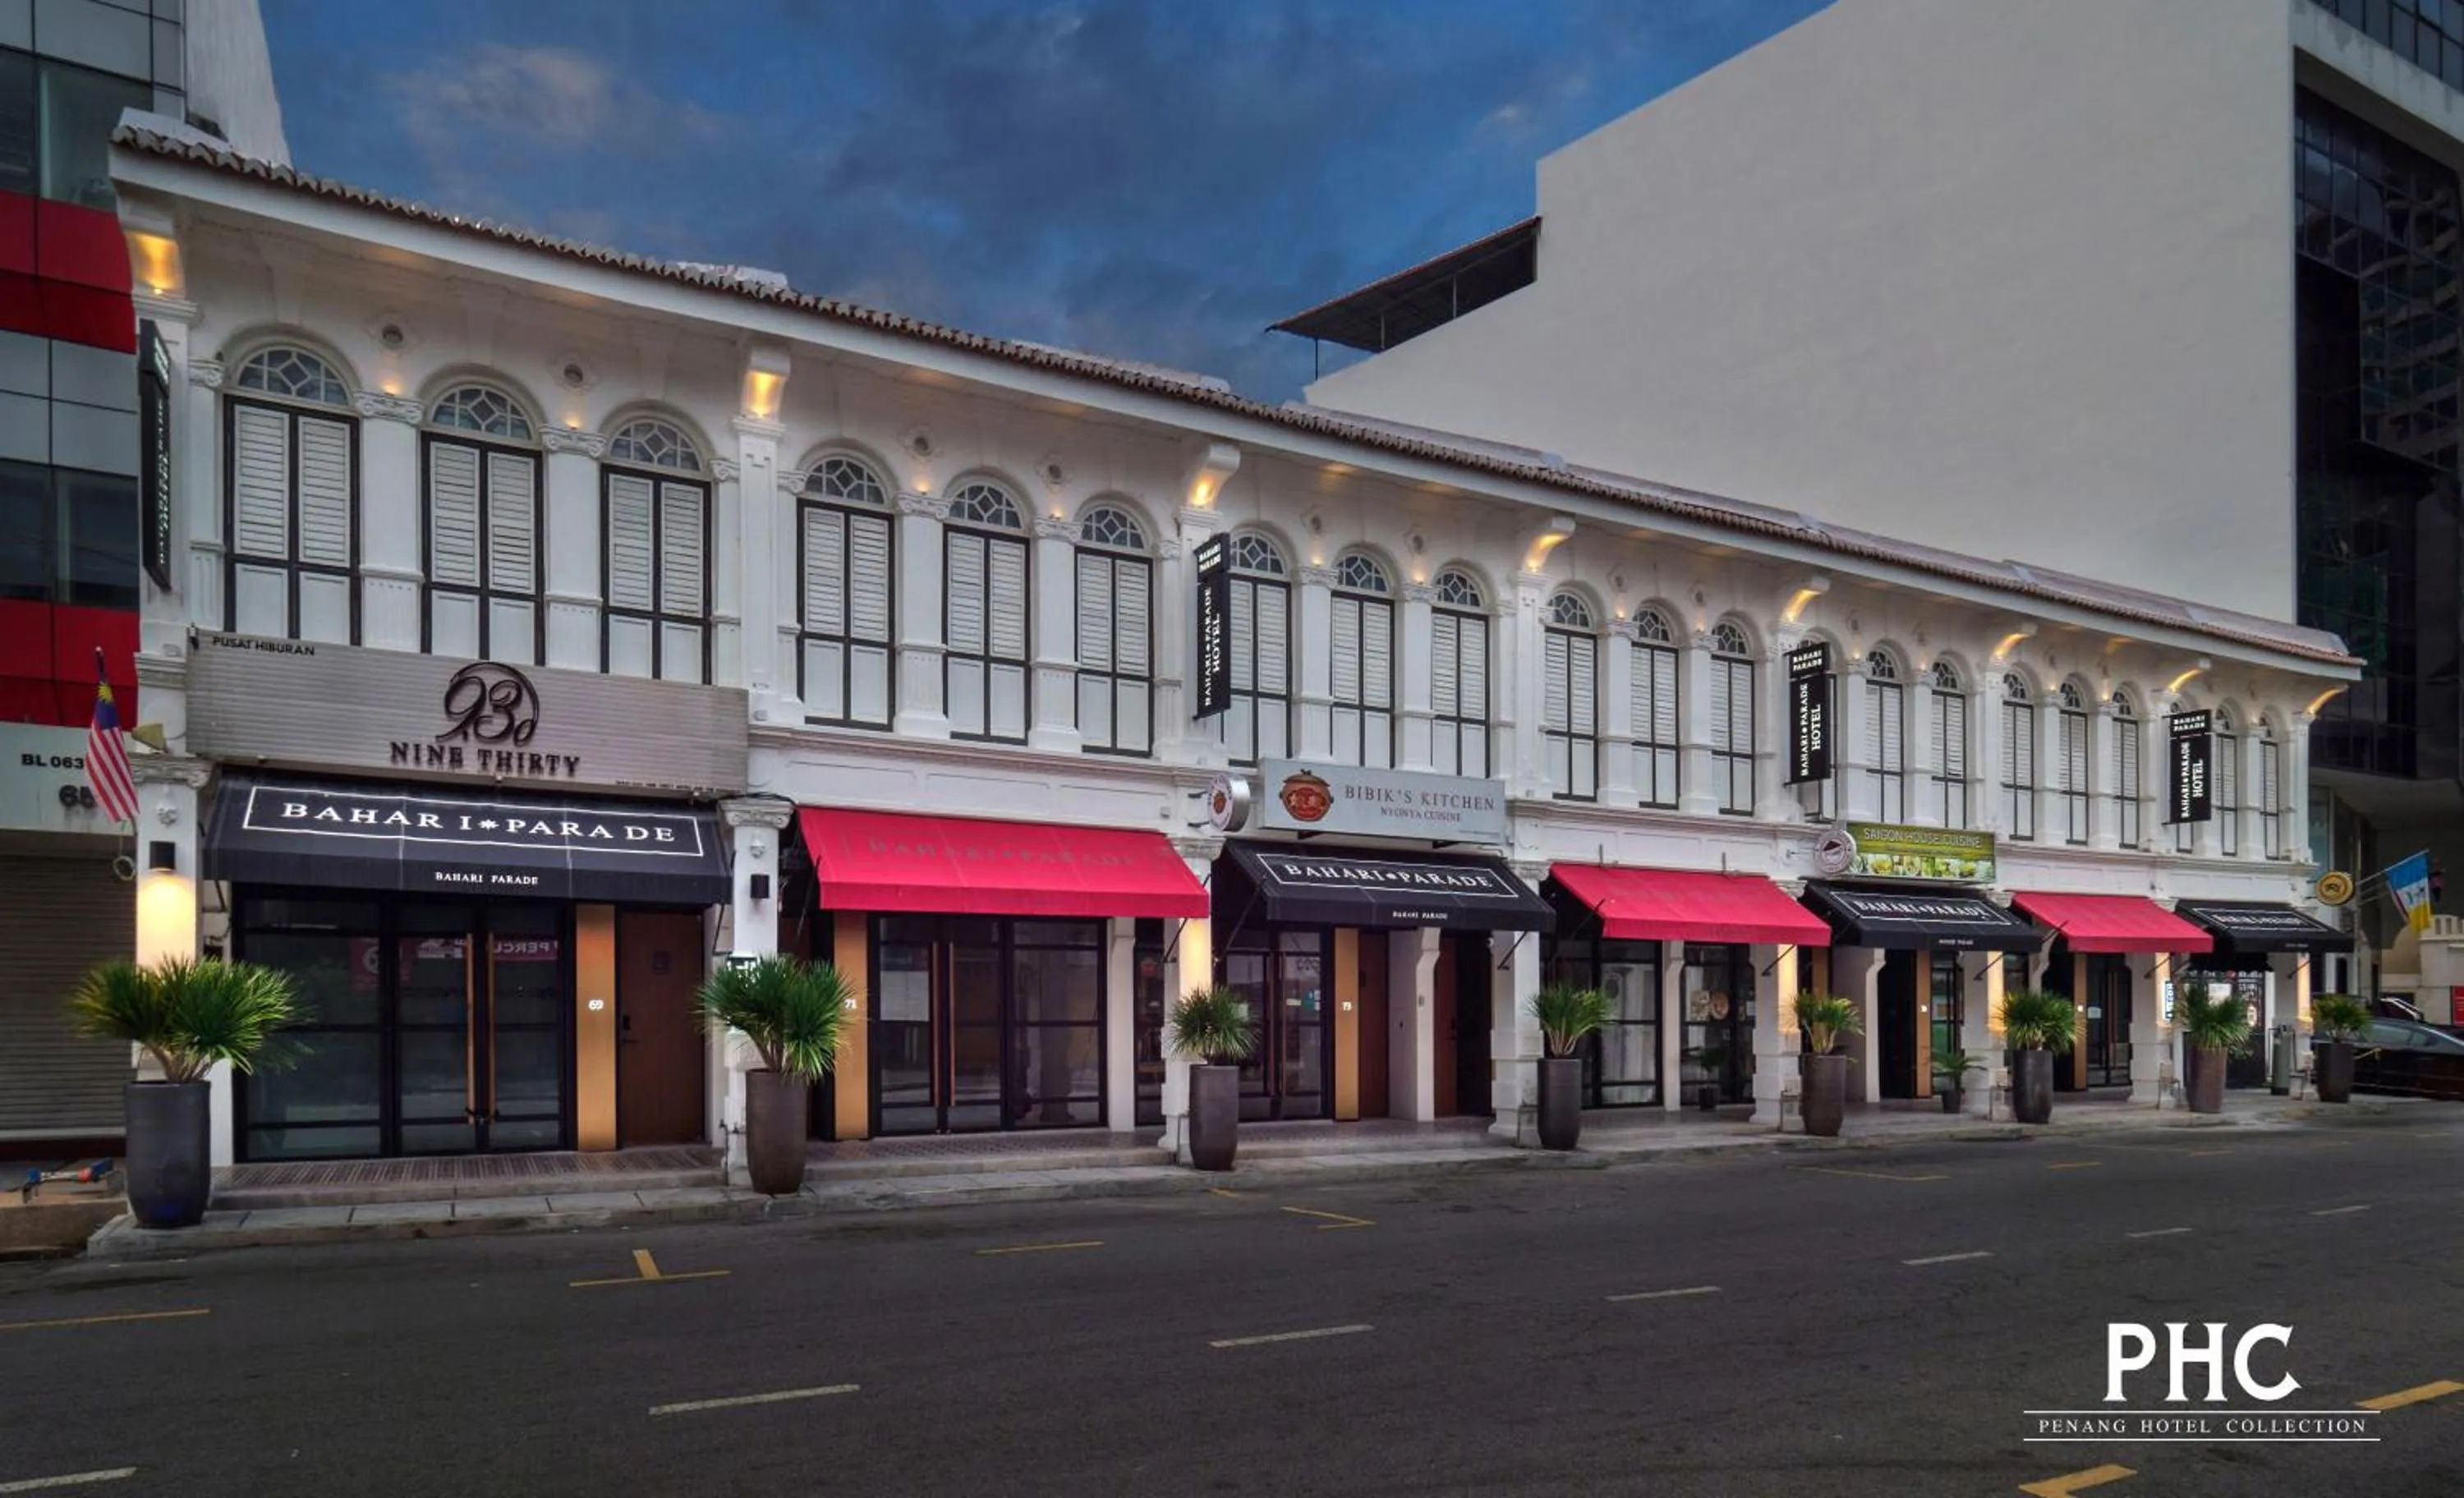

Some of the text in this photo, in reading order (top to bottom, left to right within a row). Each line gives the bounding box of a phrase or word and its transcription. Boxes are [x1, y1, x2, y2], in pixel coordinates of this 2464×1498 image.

[1212, 613, 1221, 673] HOTEL
[1793, 658, 1823, 671] PARADE
[1811, 704, 1821, 751] HOTEL
[21, 753, 47, 766] BL
[390, 742, 581, 776] NINE THIRTY
[2192, 758, 2204, 797] HOTEL
[1345, 785, 1496, 811] BIBIK'S KITCHEN
[281, 802, 675, 843] BAHARI PARADE
[1423, 811, 1462, 821] CUISINE
[434, 871, 539, 885] BAHARI PARADE
[1285, 864, 1493, 888] BAHARI PARADE
[844, 999, 857, 1009] 71
